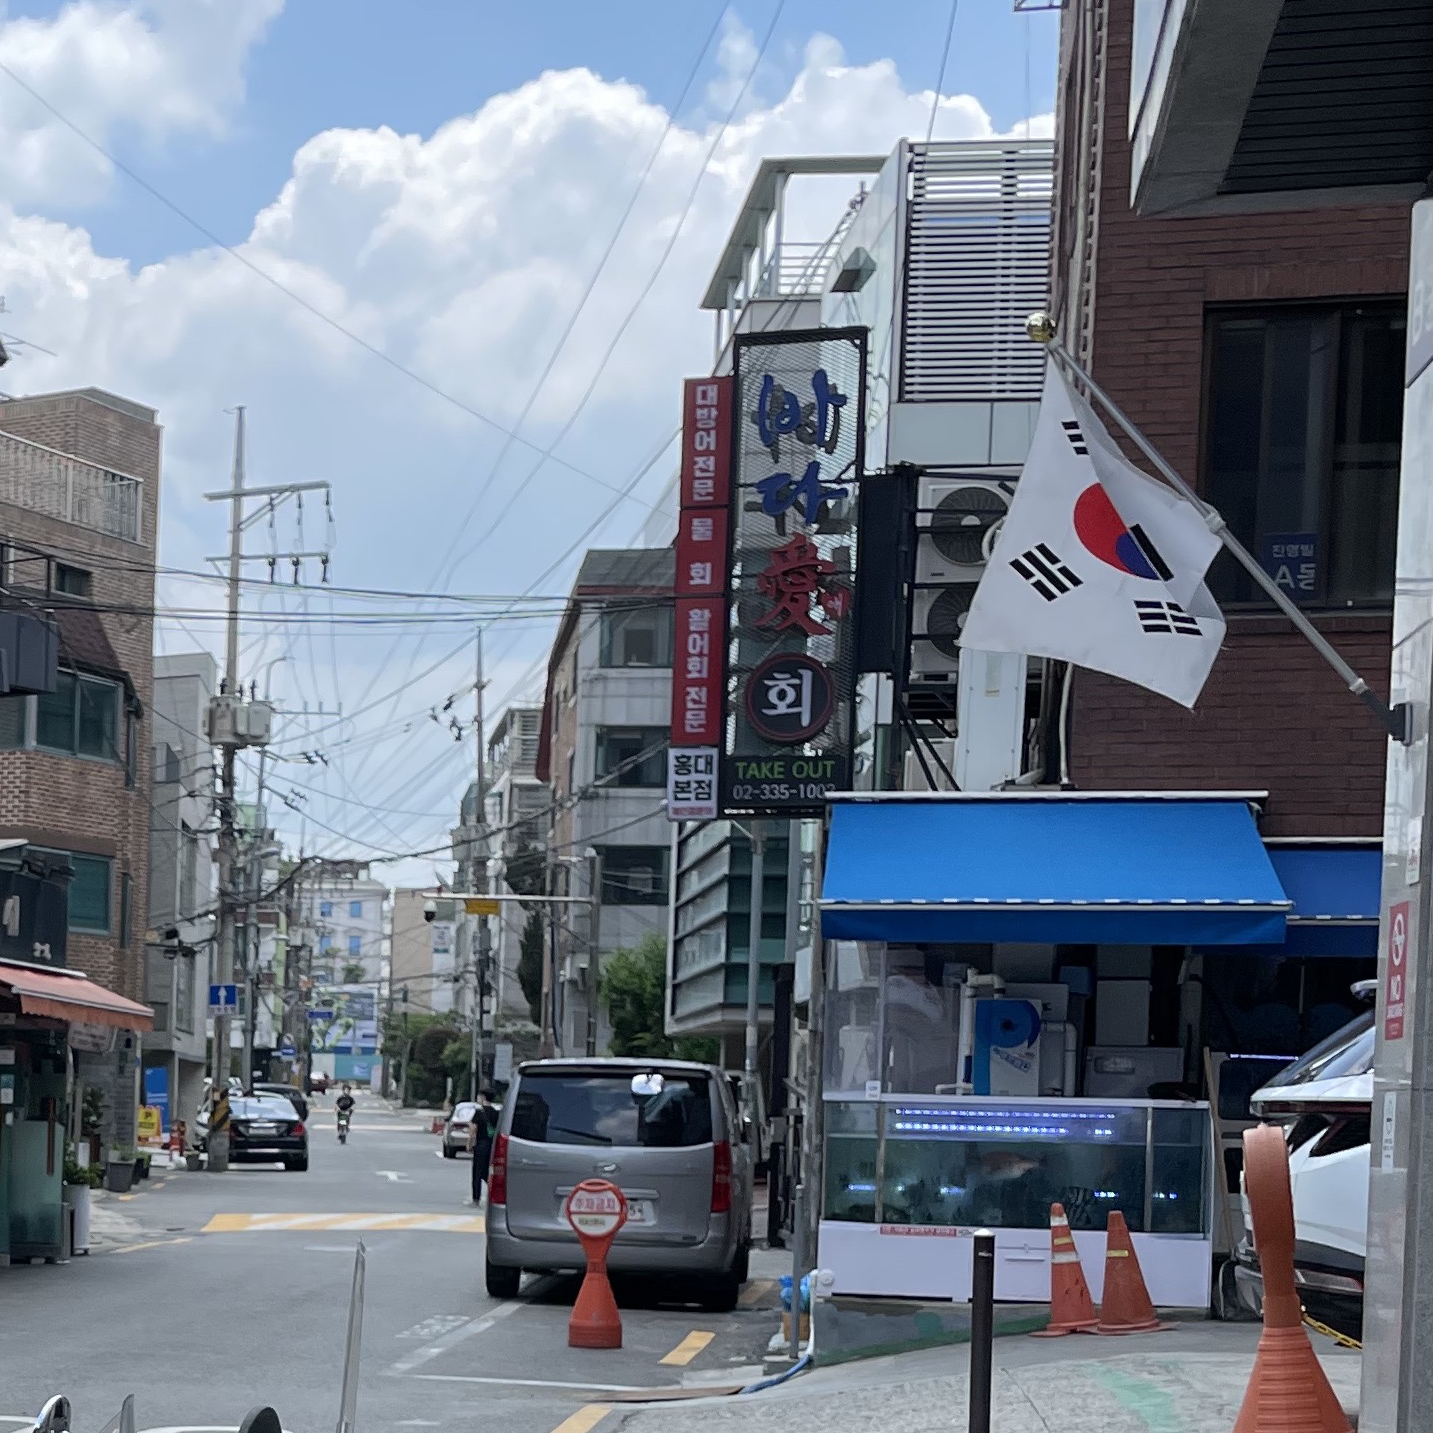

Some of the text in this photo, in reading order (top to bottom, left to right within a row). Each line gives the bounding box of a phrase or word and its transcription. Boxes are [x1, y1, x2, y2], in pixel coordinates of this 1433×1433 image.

[761, 668, 813, 728] 회
[735, 761, 835, 780] TAKE OUT
